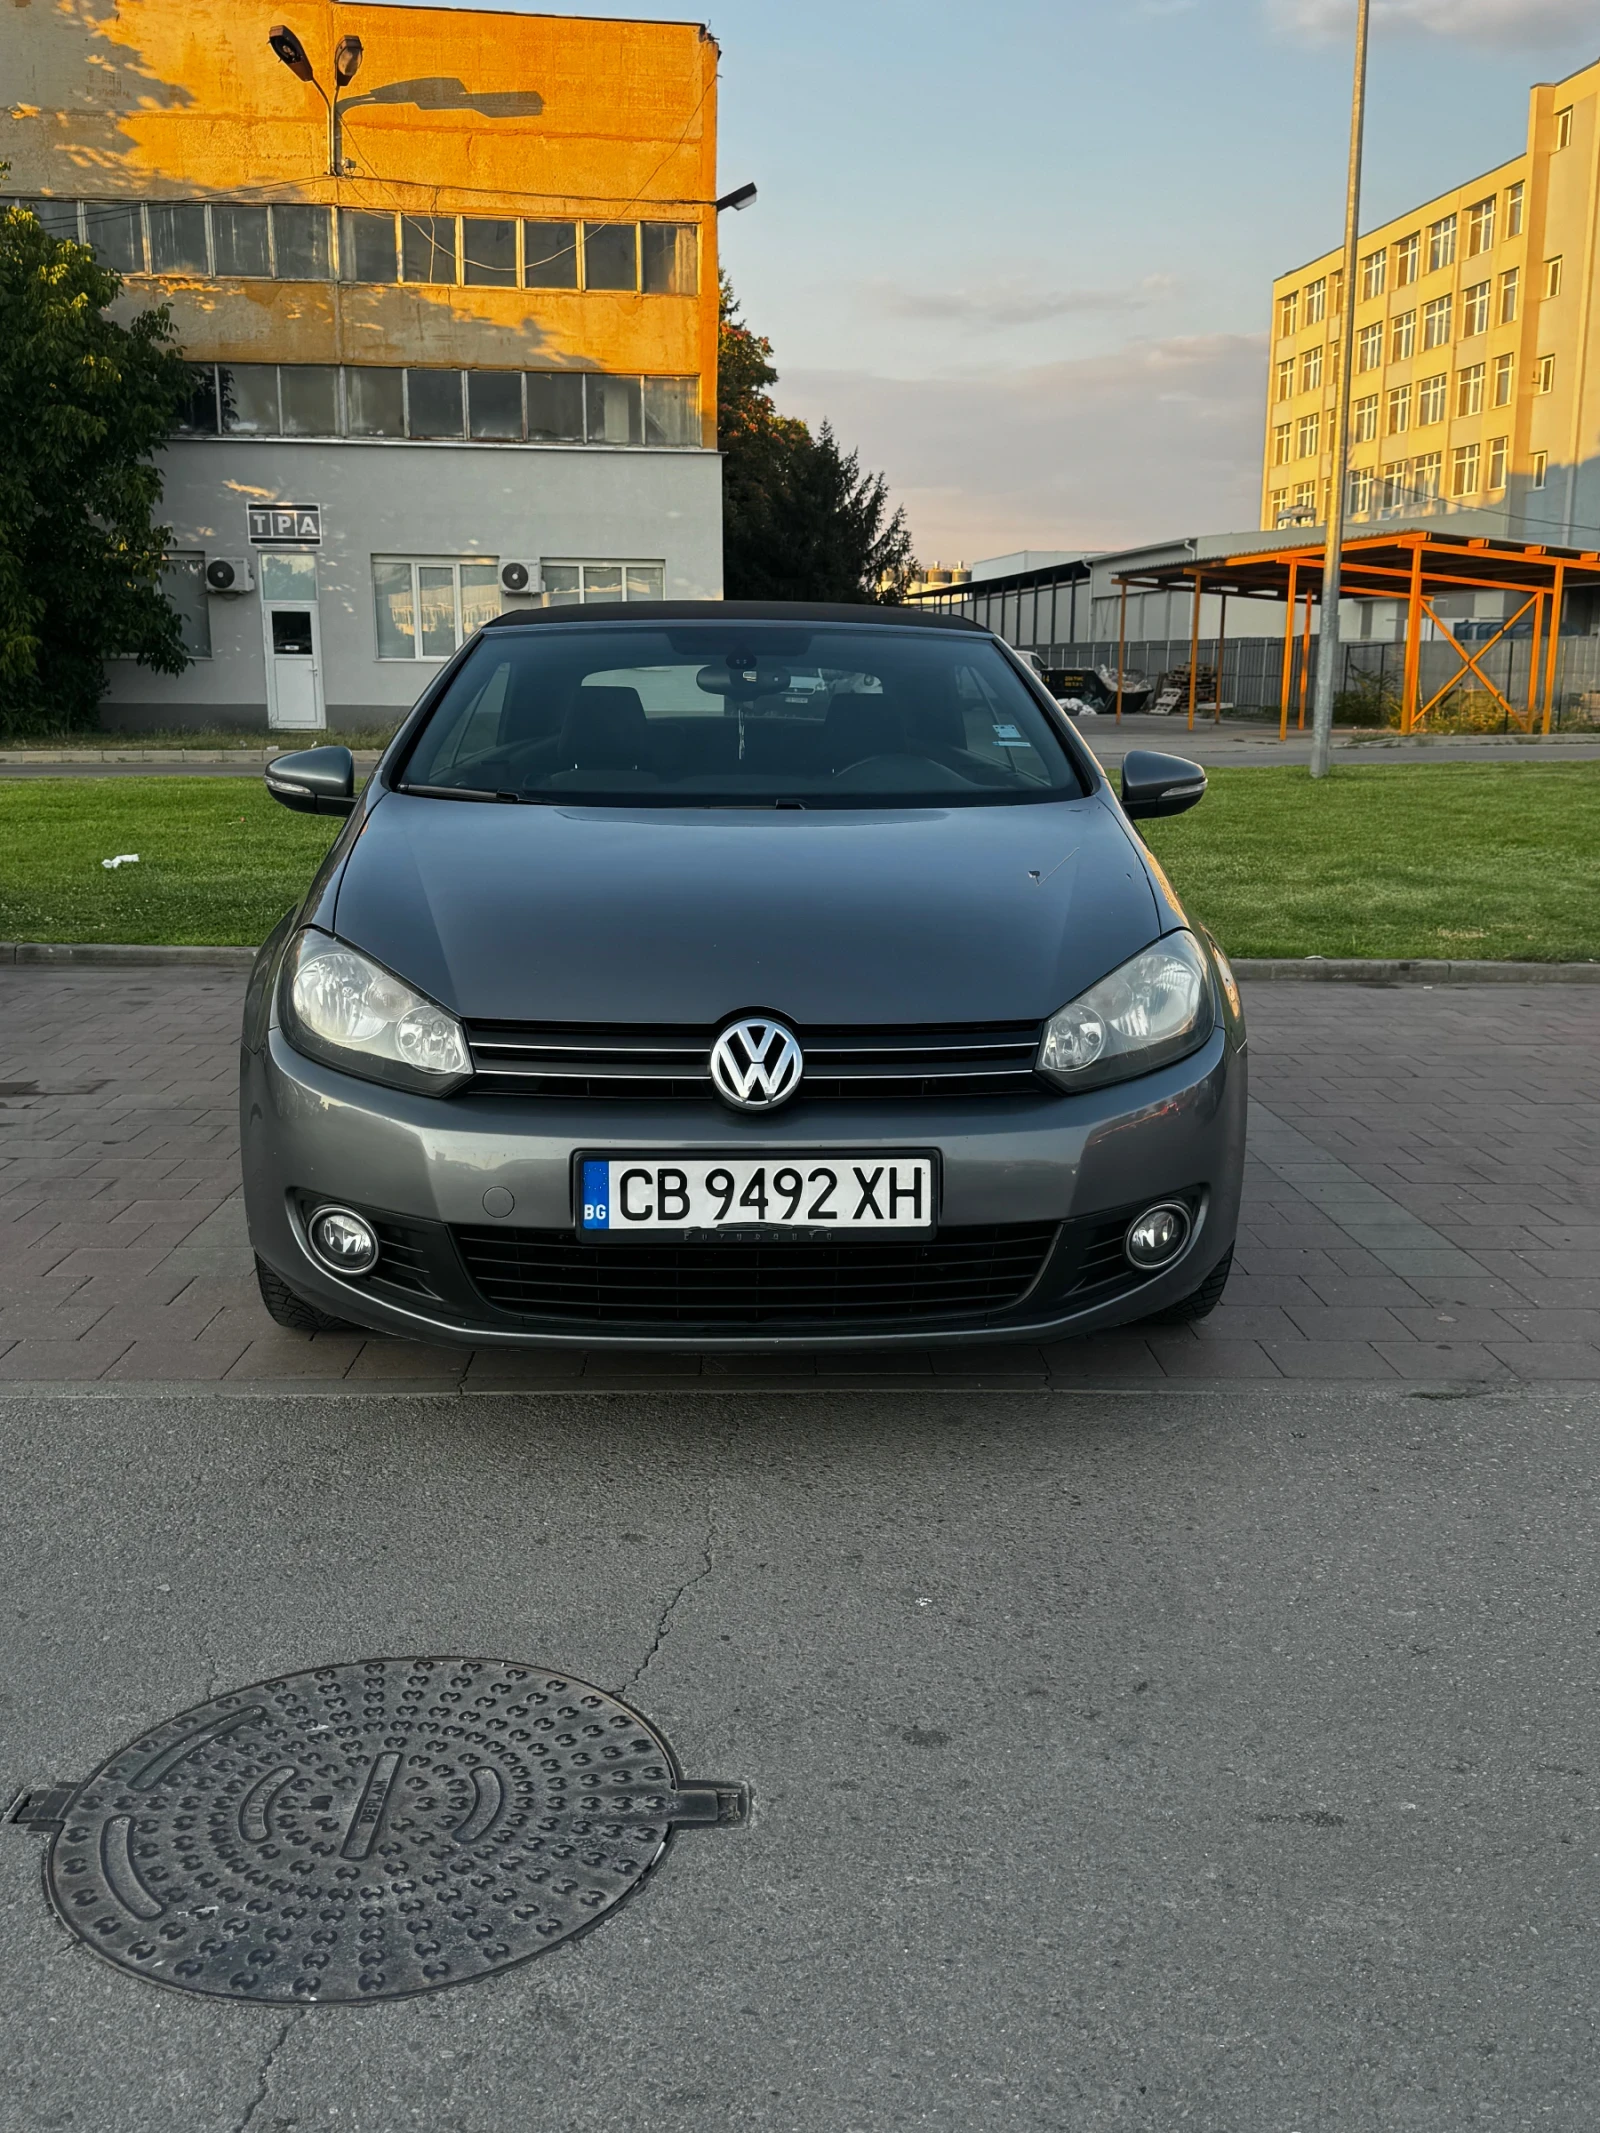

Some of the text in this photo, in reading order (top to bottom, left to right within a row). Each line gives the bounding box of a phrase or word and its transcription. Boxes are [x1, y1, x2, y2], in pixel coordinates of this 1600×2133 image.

[253, 515, 318, 534] TPA
[619, 1167, 922, 1221] CB 9492 XH
[584, 1204, 607, 1220] BG
